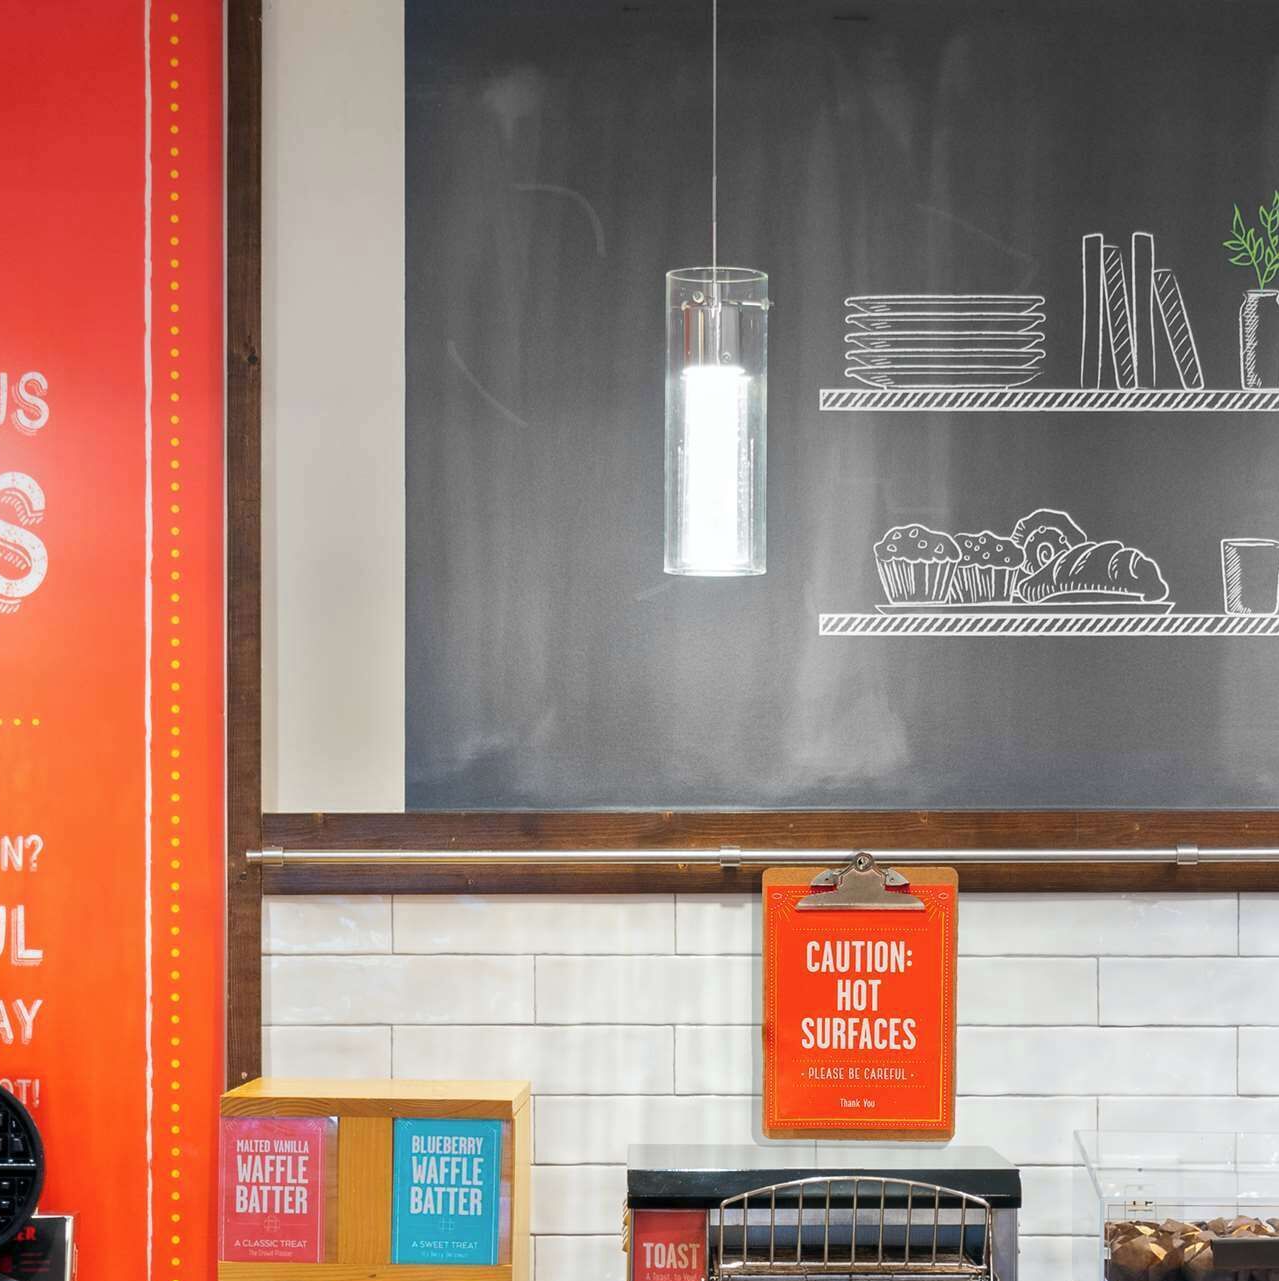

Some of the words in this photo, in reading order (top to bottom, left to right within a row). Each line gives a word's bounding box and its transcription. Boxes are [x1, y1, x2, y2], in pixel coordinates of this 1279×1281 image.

[805, 940, 914, 974] CAUTION:
[836, 979, 882, 1012] HOT
[801, 1017, 917, 1051] SURFACES
[808, 1068, 845, 1081] PLEASE
[847, 1068, 861, 1080] BE
[864, 1068, 908, 1082] CAREFUL
[839, 1098, 861, 1108] Thank
[863, 1098, 876, 1108] You
[236, 1139, 272, 1153] MALTED
[273, 1140, 310, 1154] VANILLA
[411, 1136, 484, 1155] BLUEBERRY
[236, 1155, 309, 1185] WAFFLE
[411, 1157, 484, 1186] WAFFLE
[234, 1186, 308, 1214] BATTER
[409, 1187, 483, 1217] BATTER
[234, 1240, 241, 1248] A
[242, 1240, 278, 1248] CLASSIC
[280, 1240, 308, 1249] TREAT
[411, 1240, 418, 1248] A
[419, 1240, 450, 1249] SWEET
[451, 1241, 478, 1249] TREAT
[642, 1242, 700, 1269] TOAST
